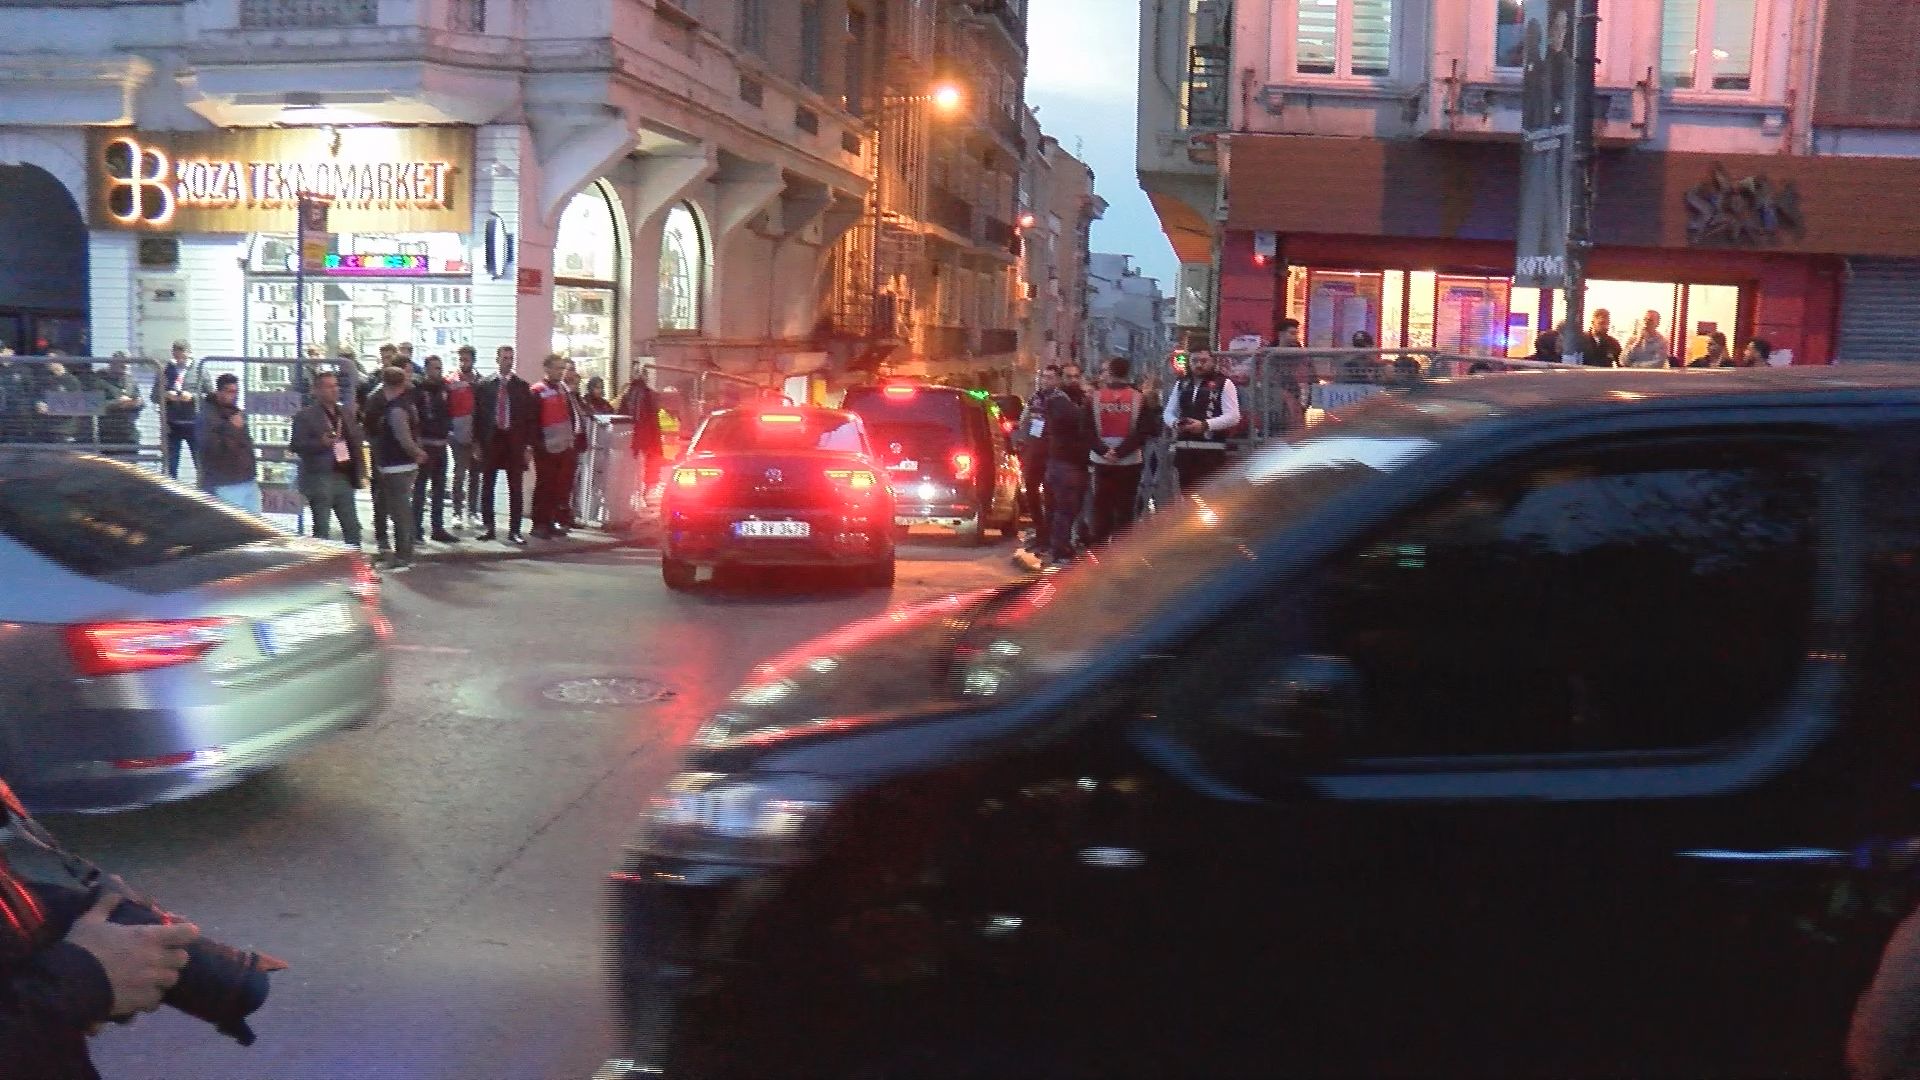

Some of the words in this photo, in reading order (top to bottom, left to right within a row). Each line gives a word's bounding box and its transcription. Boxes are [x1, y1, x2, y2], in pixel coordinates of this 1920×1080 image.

[174, 161, 241, 200] KOZA
[248, 161, 447, 200] TEKNOMARKET
[744, 523, 756, 535] 34
[761, 523, 774, 535] RV
